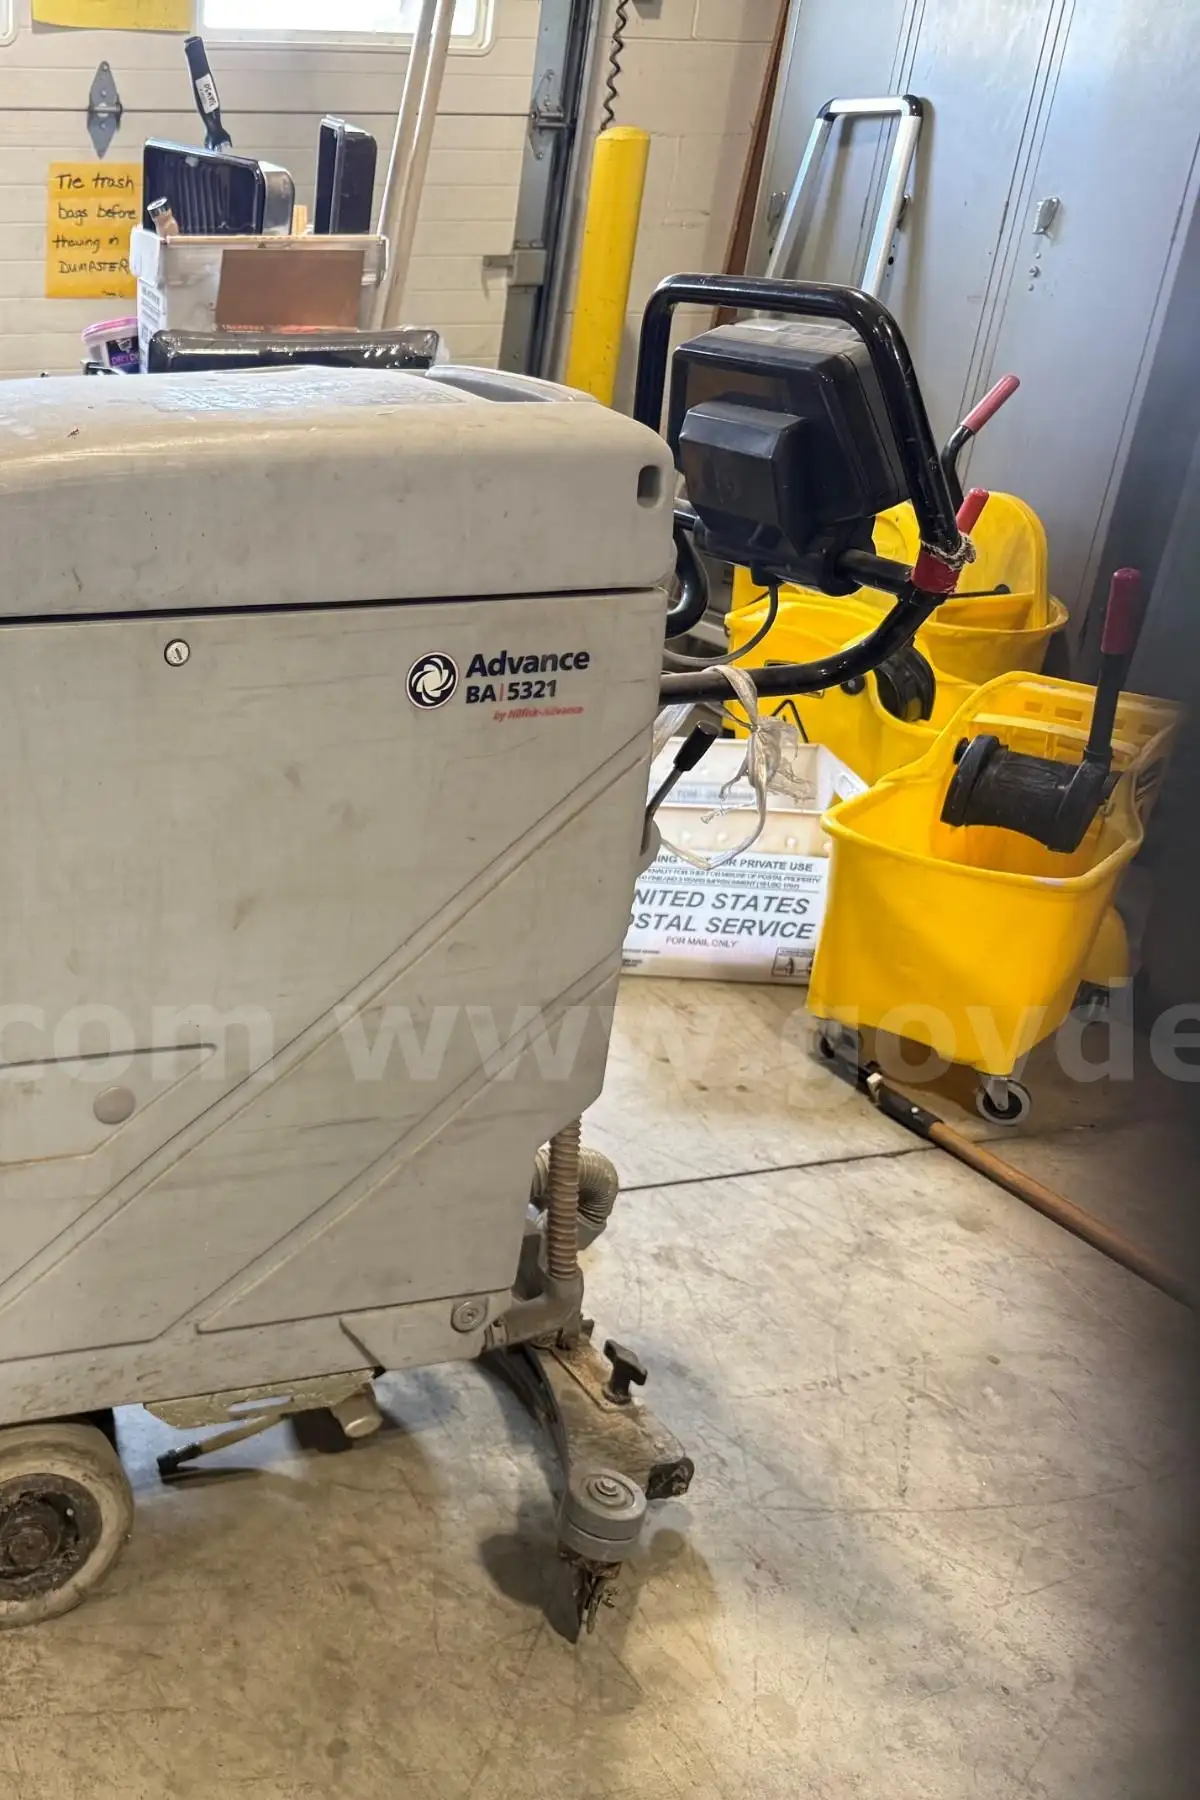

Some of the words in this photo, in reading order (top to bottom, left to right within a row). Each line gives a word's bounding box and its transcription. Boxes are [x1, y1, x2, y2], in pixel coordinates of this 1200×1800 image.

[57, 173, 85, 189] Tie
[92, 172, 134, 194] trash
[97, 204, 137, 220] before
[465, 650, 589, 678] Advance
[740, 859, 787, 870] PRIVATE
[789, 862, 813, 873] USE
[634, 888, 705, 908] NITED
[711, 893, 810, 914] STATES
[631, 912, 696, 932] STAL
[705, 916, 816, 940] SERVICE
[689, 937, 710, 947] MAIL
[711, 939, 738, 949] ONLY
